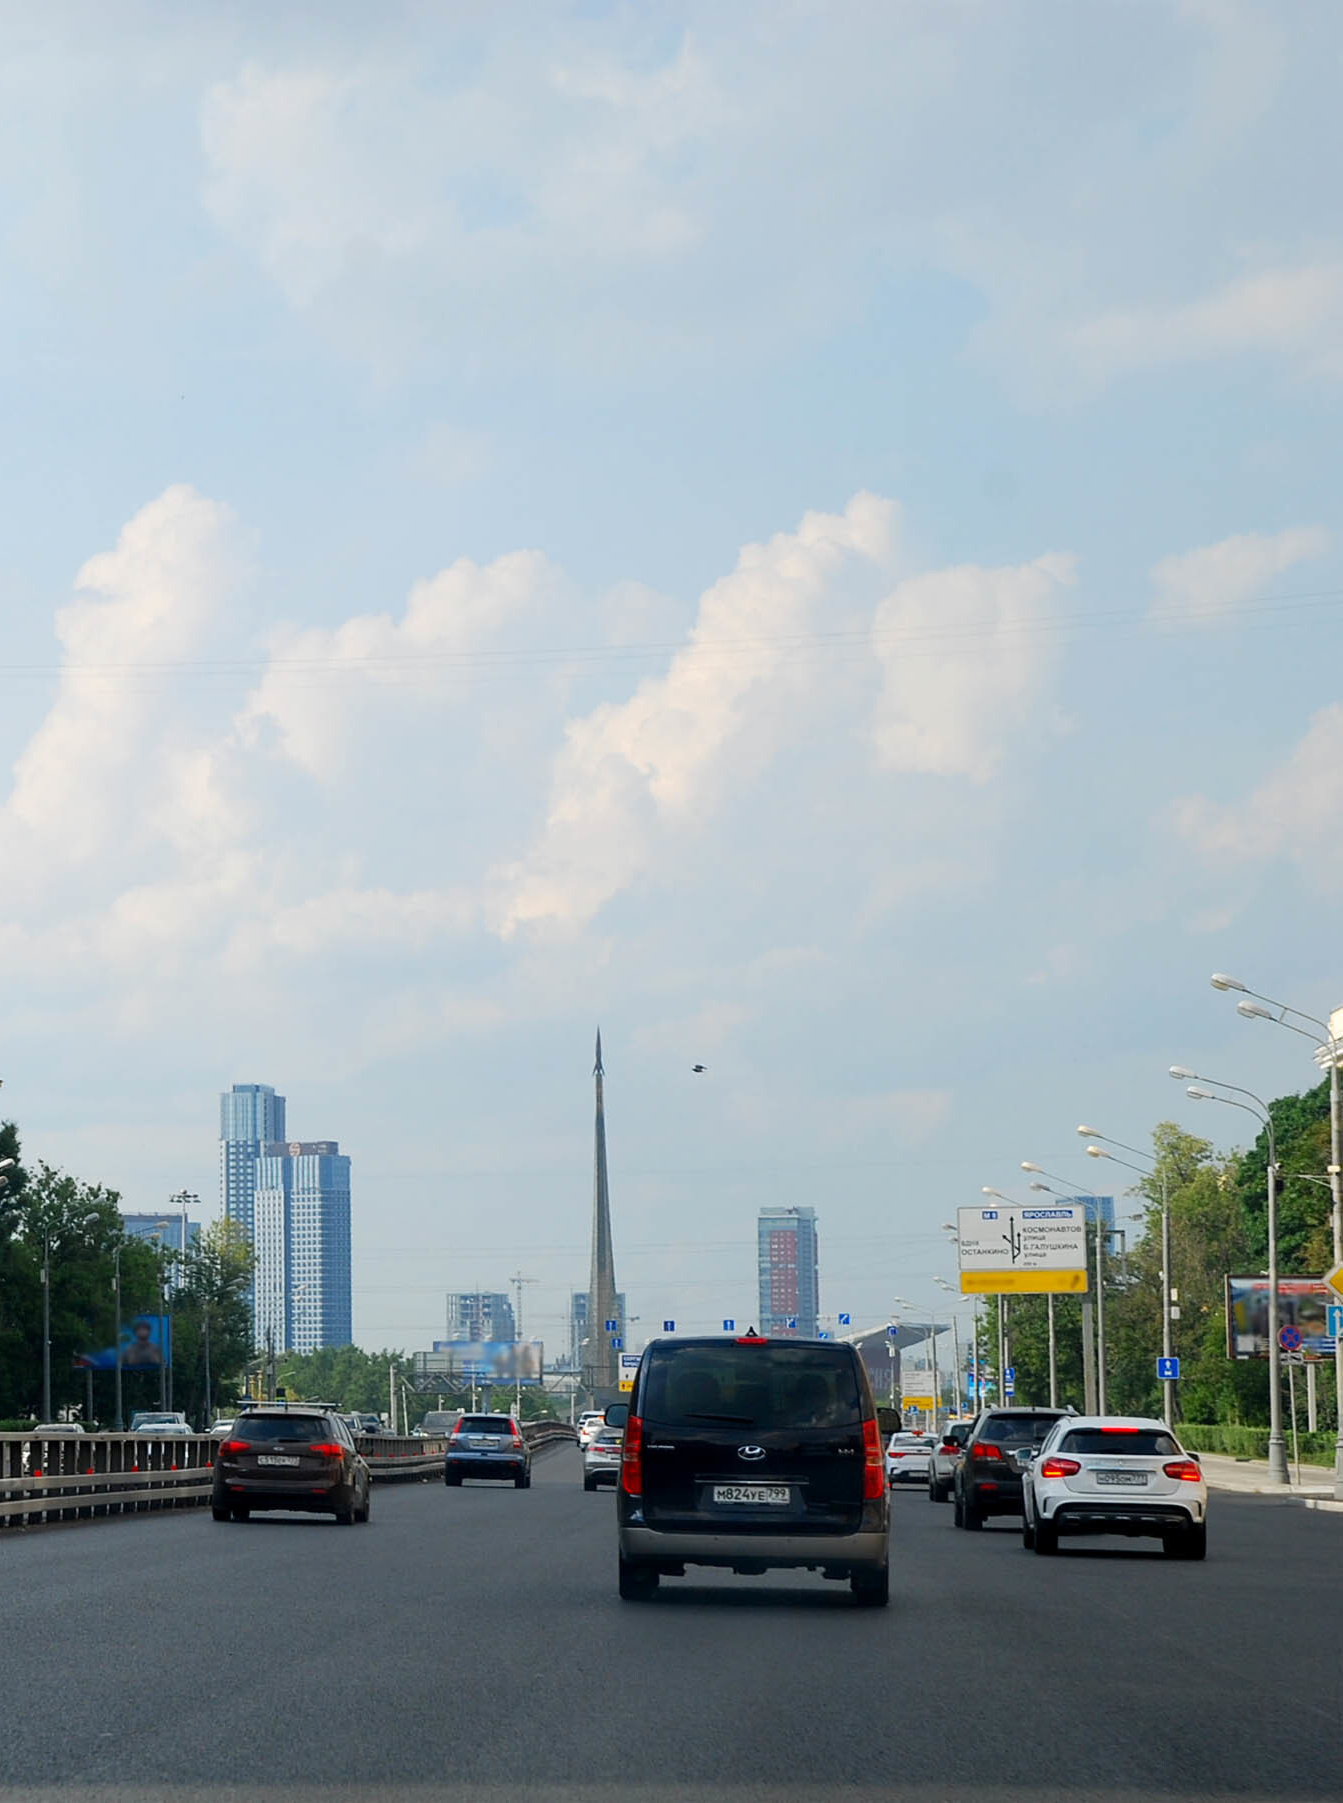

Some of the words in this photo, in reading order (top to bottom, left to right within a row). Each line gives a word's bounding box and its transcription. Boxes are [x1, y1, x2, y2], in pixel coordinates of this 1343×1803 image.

[1023, 1210, 1073, 1219] ЯРОСЛАВЛЬ
[961, 1248, 1009, 1256] ОСТАНКИНО
[768, 1488, 786, 1498] 799
